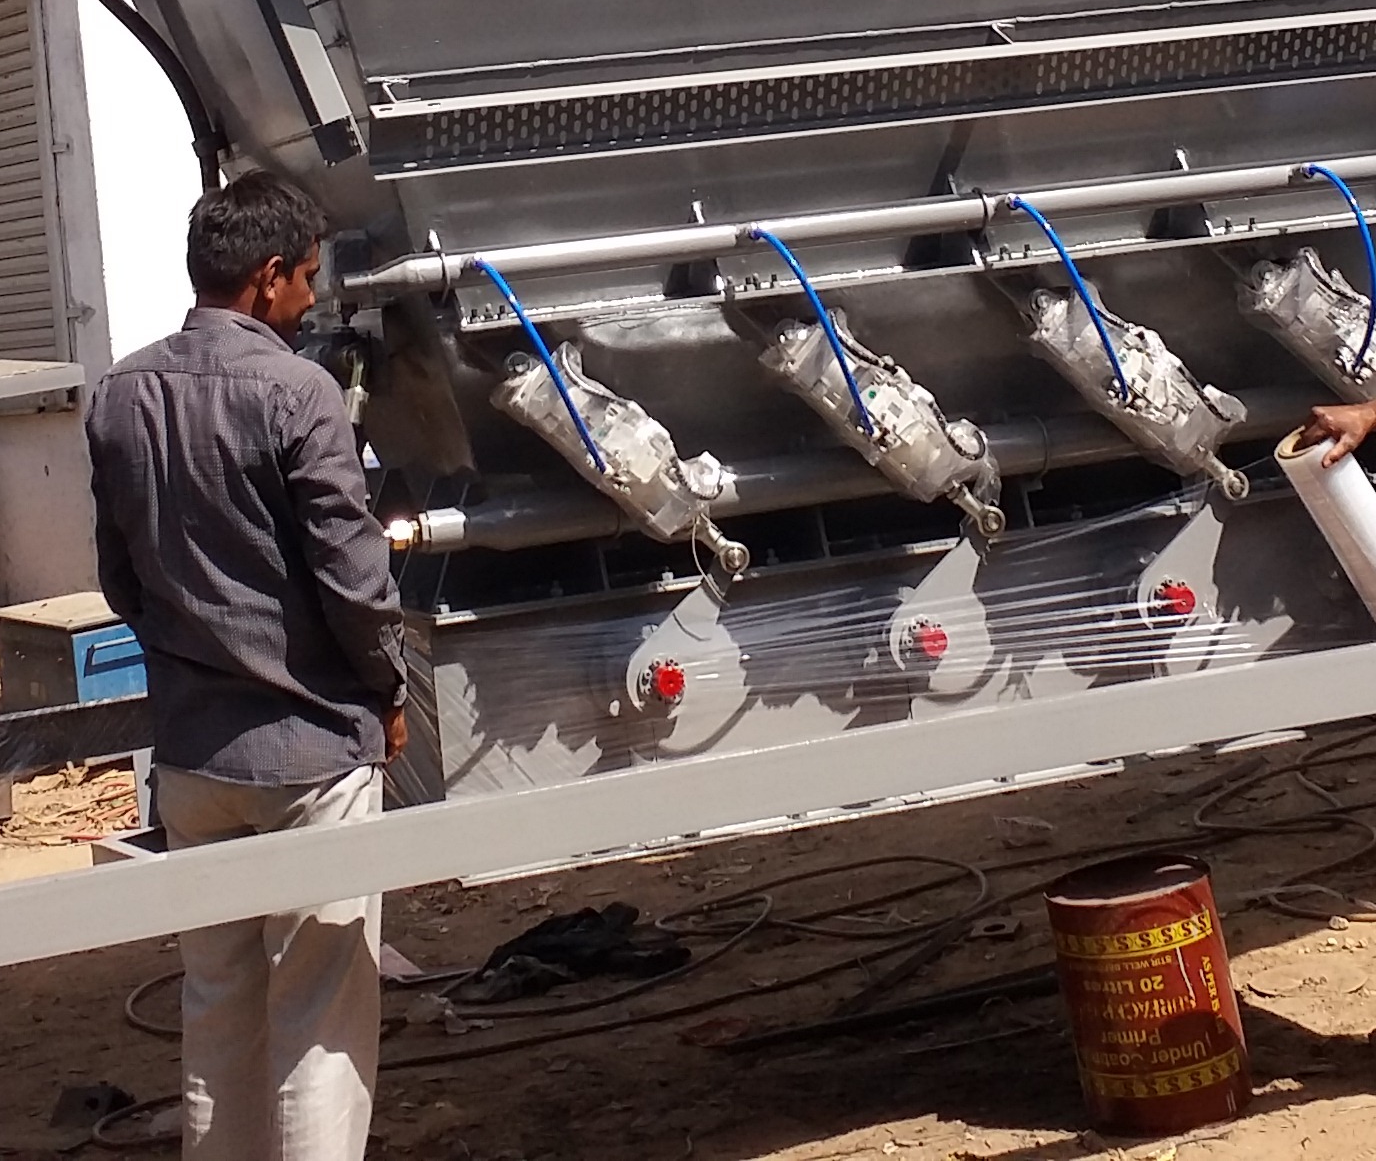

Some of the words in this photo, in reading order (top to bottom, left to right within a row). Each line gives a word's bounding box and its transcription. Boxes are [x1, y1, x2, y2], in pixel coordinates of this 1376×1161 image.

[1139, 974, 1165, 993] 20
[1101, 1027, 1163, 1048] Primer
[1151, 1040, 1208, 1065] Under
